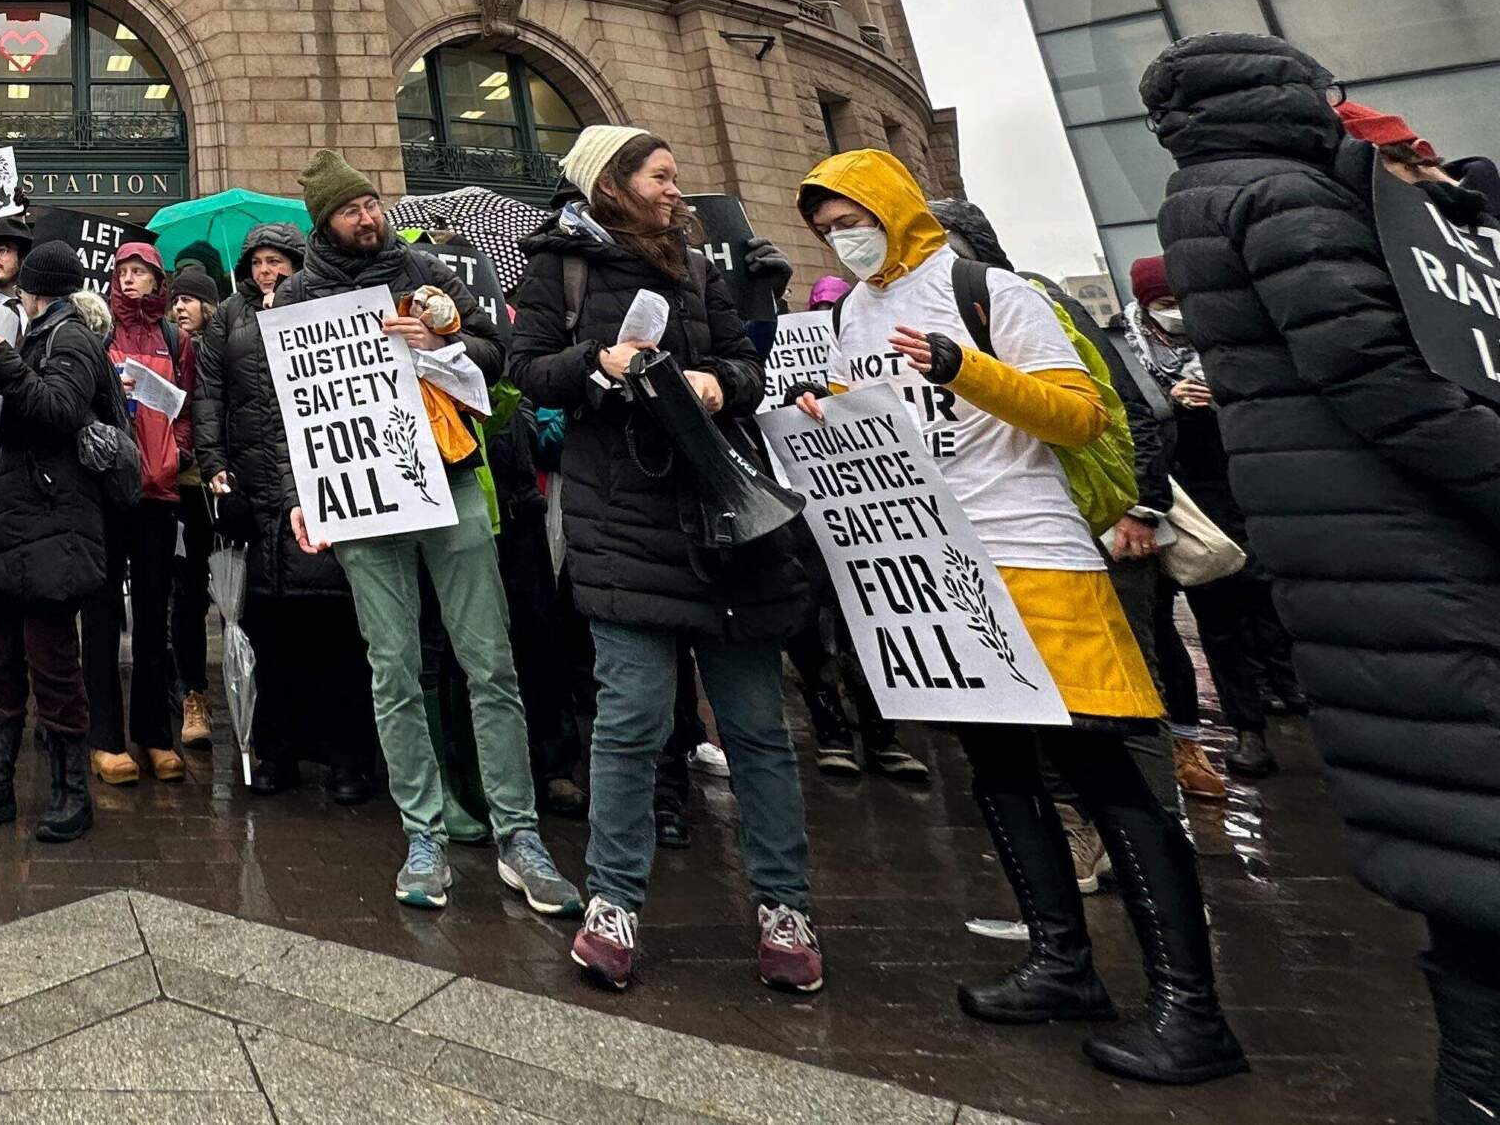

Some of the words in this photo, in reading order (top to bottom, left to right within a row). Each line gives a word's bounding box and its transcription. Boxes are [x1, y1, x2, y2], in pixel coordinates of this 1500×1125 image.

[22, 174, 169, 194] STATION
[81, 219, 124, 248] LET
[76, 247, 116, 273] AFA
[279, 308, 386, 352] EQUALITY
[774, 325, 830, 346] UALIT
[287, 336, 394, 382] JUSTICE
[765, 345, 830, 370] USTIC
[850, 353, 904, 381] NOT
[293, 368, 399, 417] SAFETY
[303, 416, 381, 469] FOR
[784, 413, 901, 462] EQUALITY
[317, 467, 399, 523] ALL
[808, 450, 925, 500] JUSTICE
[823, 494, 949, 548] SAFETY
[846, 553, 948, 616] FOR
[875, 624, 986, 689] ALL
